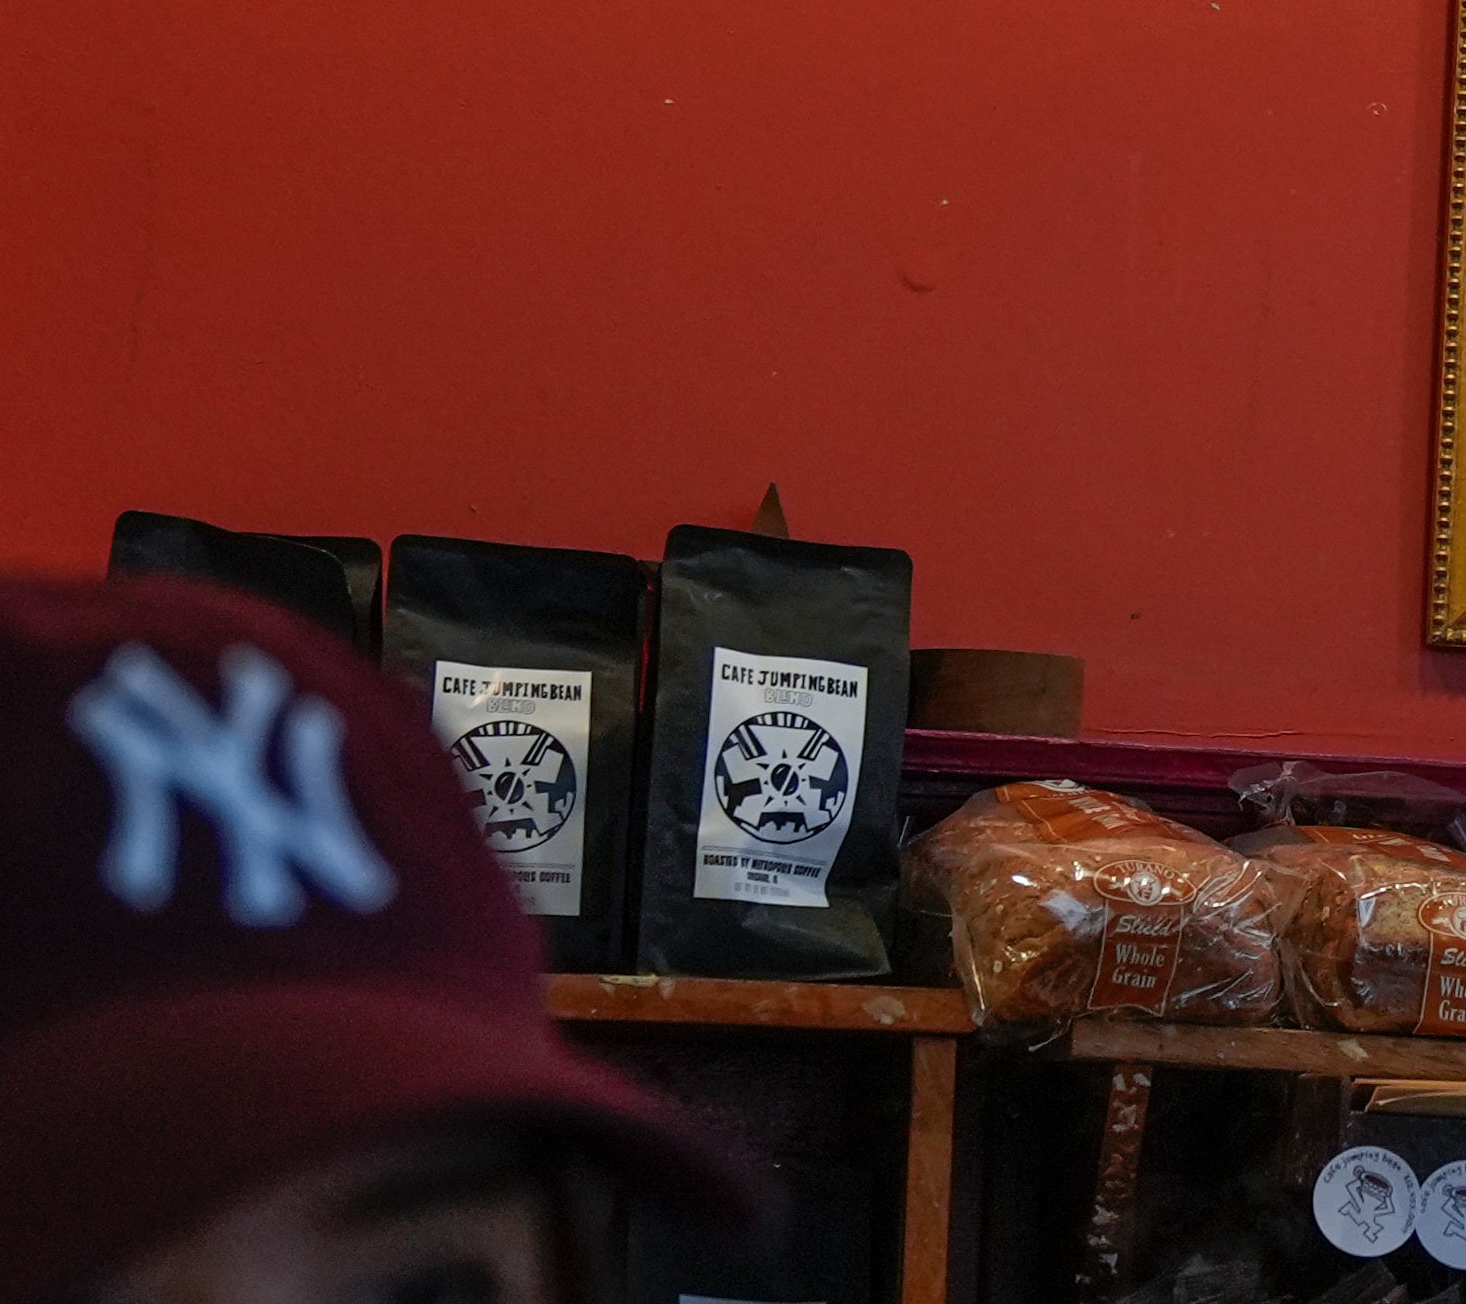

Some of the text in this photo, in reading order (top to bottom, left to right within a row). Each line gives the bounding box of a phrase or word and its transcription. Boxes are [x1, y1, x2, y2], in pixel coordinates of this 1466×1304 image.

[722, 664, 754, 685] CAFE
[443, 677, 476, 696] CAFE
[1114, 861, 1176, 880] TURANO
[1115, 943, 1166, 967] Whole
[1112, 966, 1158, 989] Grain
